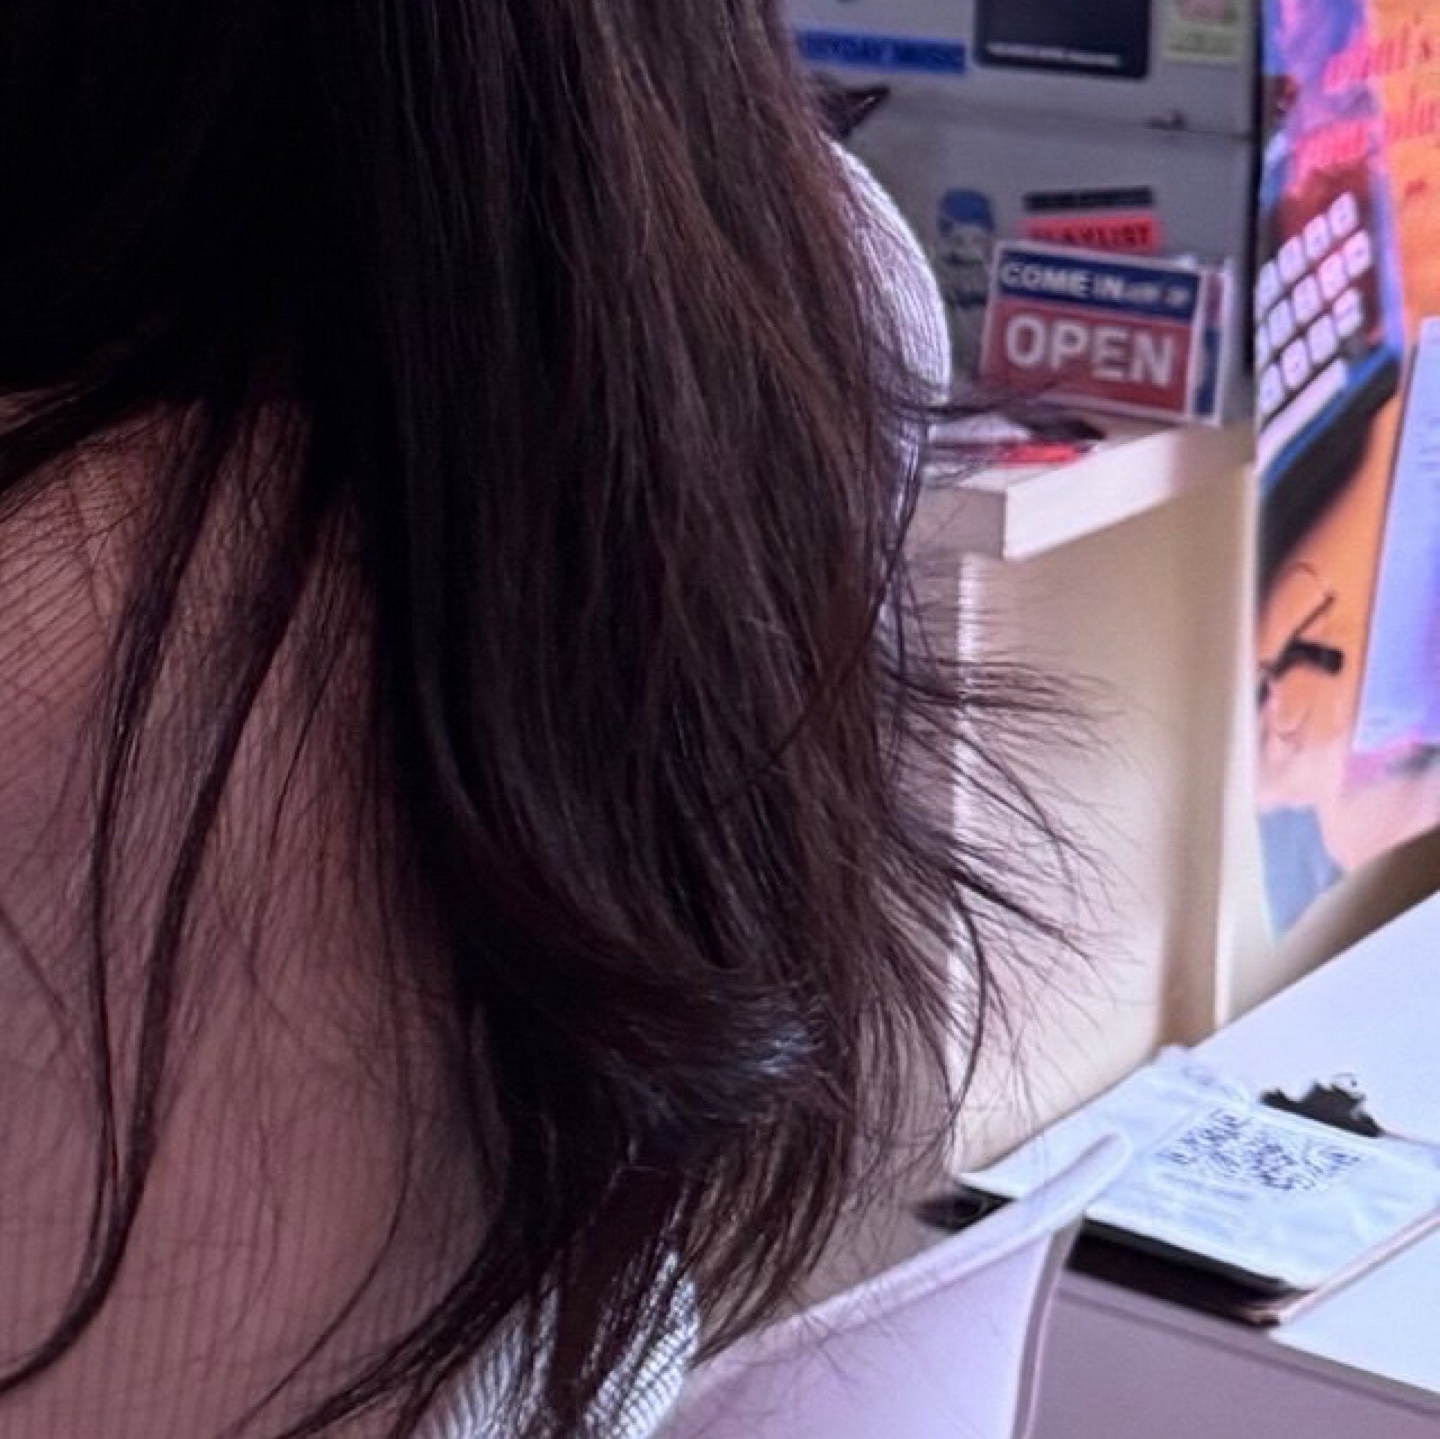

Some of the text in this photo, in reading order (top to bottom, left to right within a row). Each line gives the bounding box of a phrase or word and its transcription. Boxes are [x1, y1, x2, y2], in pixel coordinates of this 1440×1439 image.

[1001, 263, 1092, 300] COME
[1094, 275, 1124, 301] IN
[1005, 315, 1176, 390] OPEN
